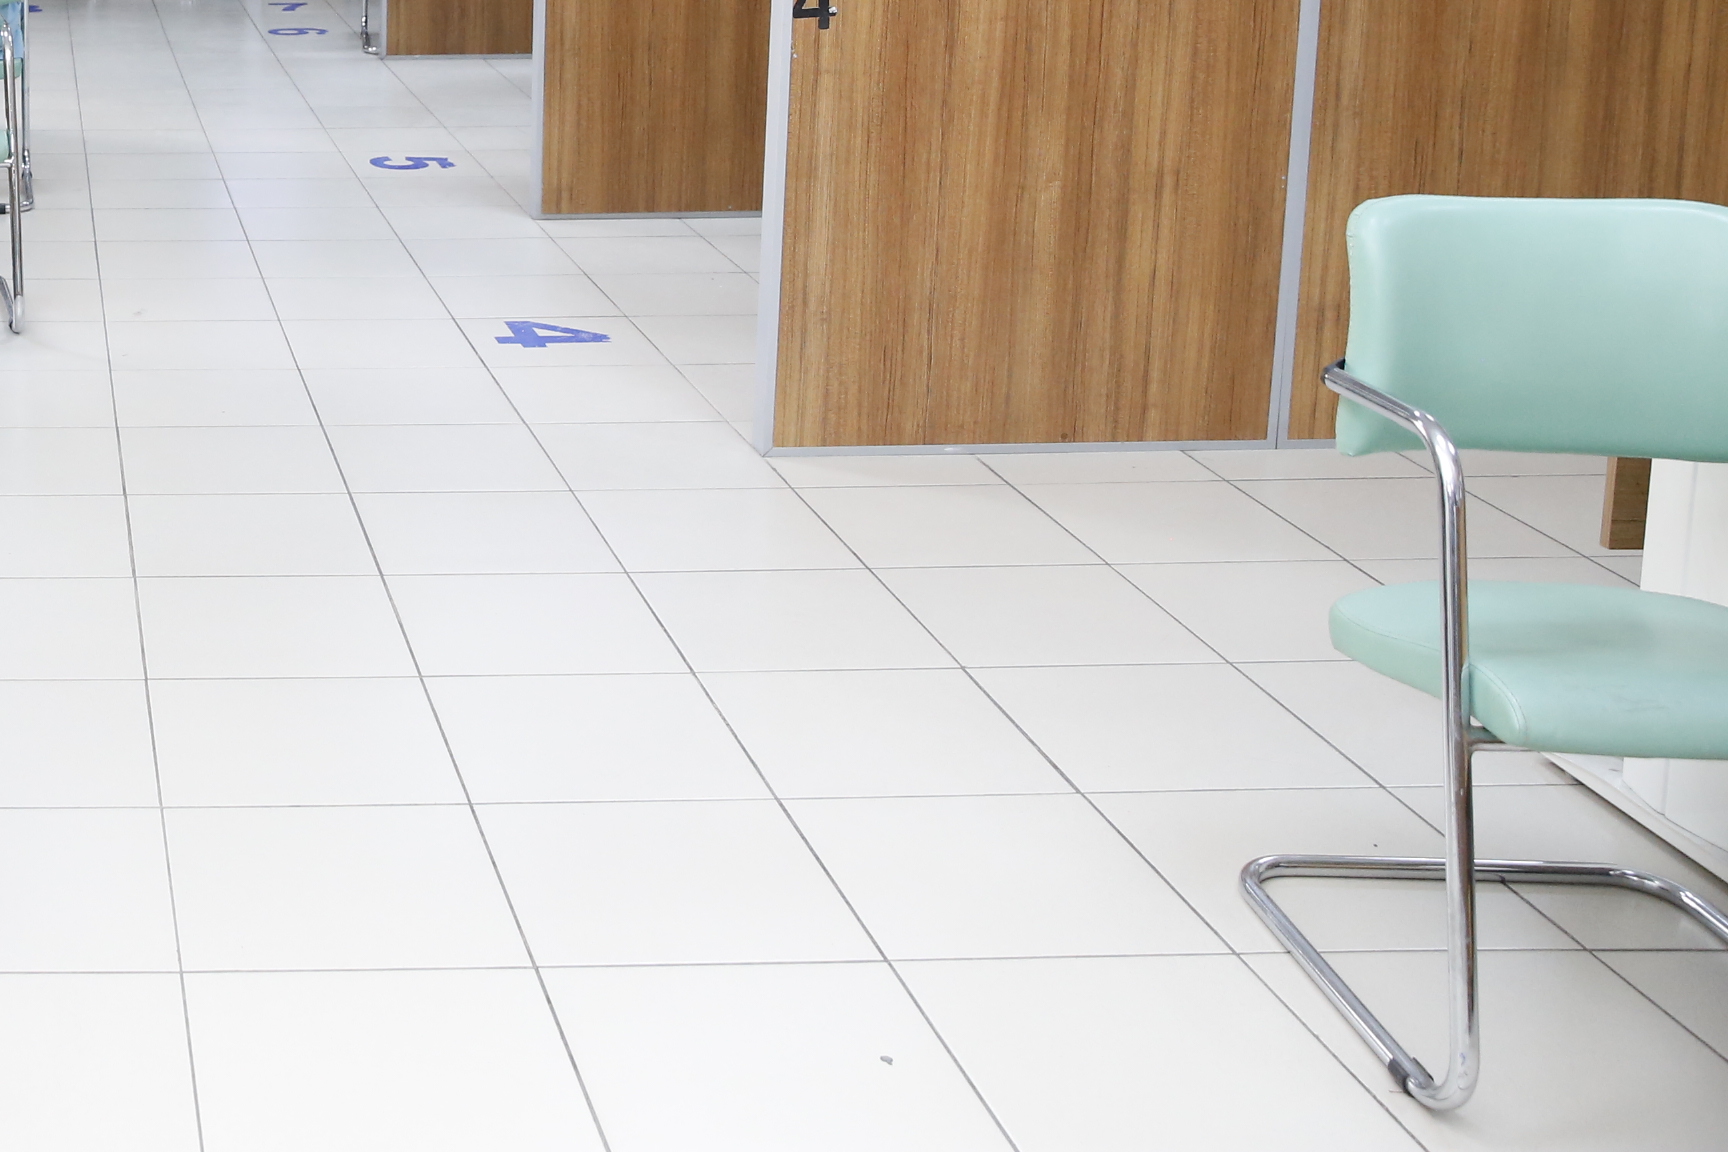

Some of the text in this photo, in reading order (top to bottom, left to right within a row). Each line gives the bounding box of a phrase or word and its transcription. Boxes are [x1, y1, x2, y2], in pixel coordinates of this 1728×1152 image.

[267, 2, 308, 12] 7
[267, 27, 328, 36] 6
[369, 156, 457, 170] 5
[494, 320, 612, 348] 4
